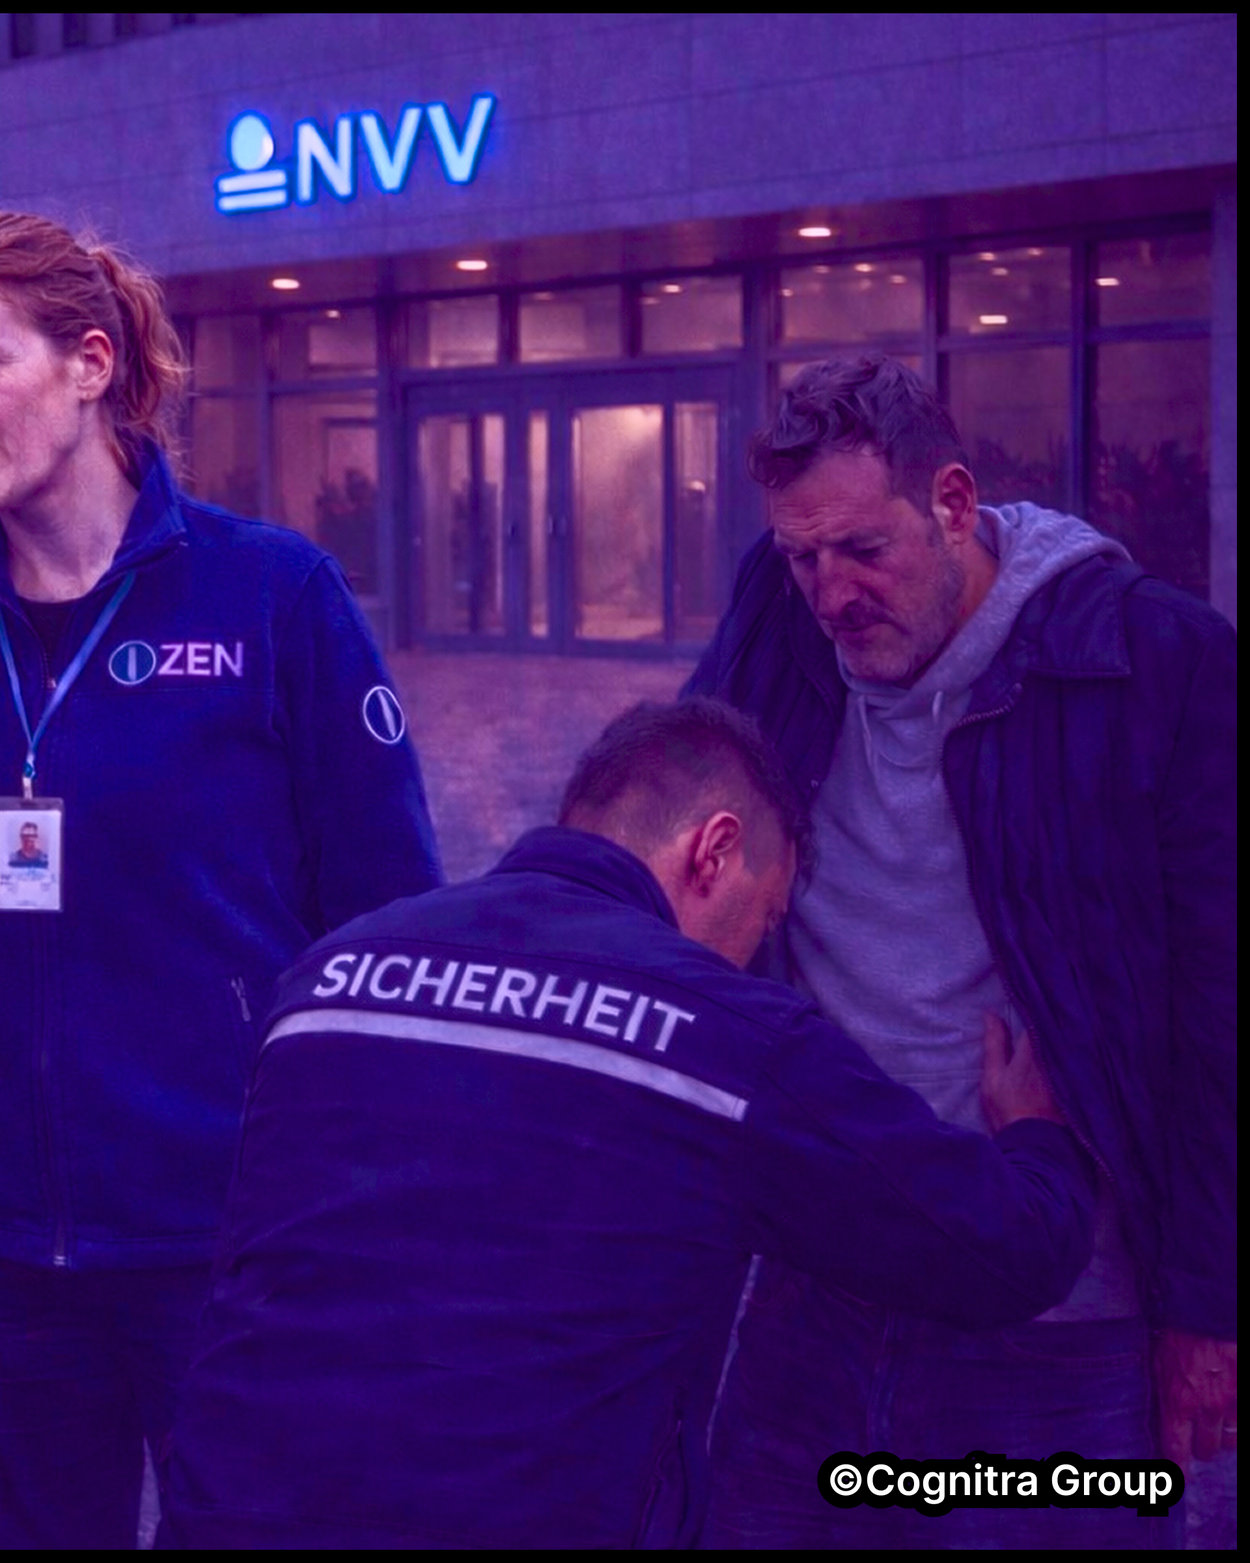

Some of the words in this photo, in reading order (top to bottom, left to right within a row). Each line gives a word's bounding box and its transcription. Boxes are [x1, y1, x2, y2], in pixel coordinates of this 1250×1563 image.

[297, 96, 494, 202] NVV
[158, 641, 244, 677] ZEN
[312, 952, 695, 1053] SICHERHEIT
